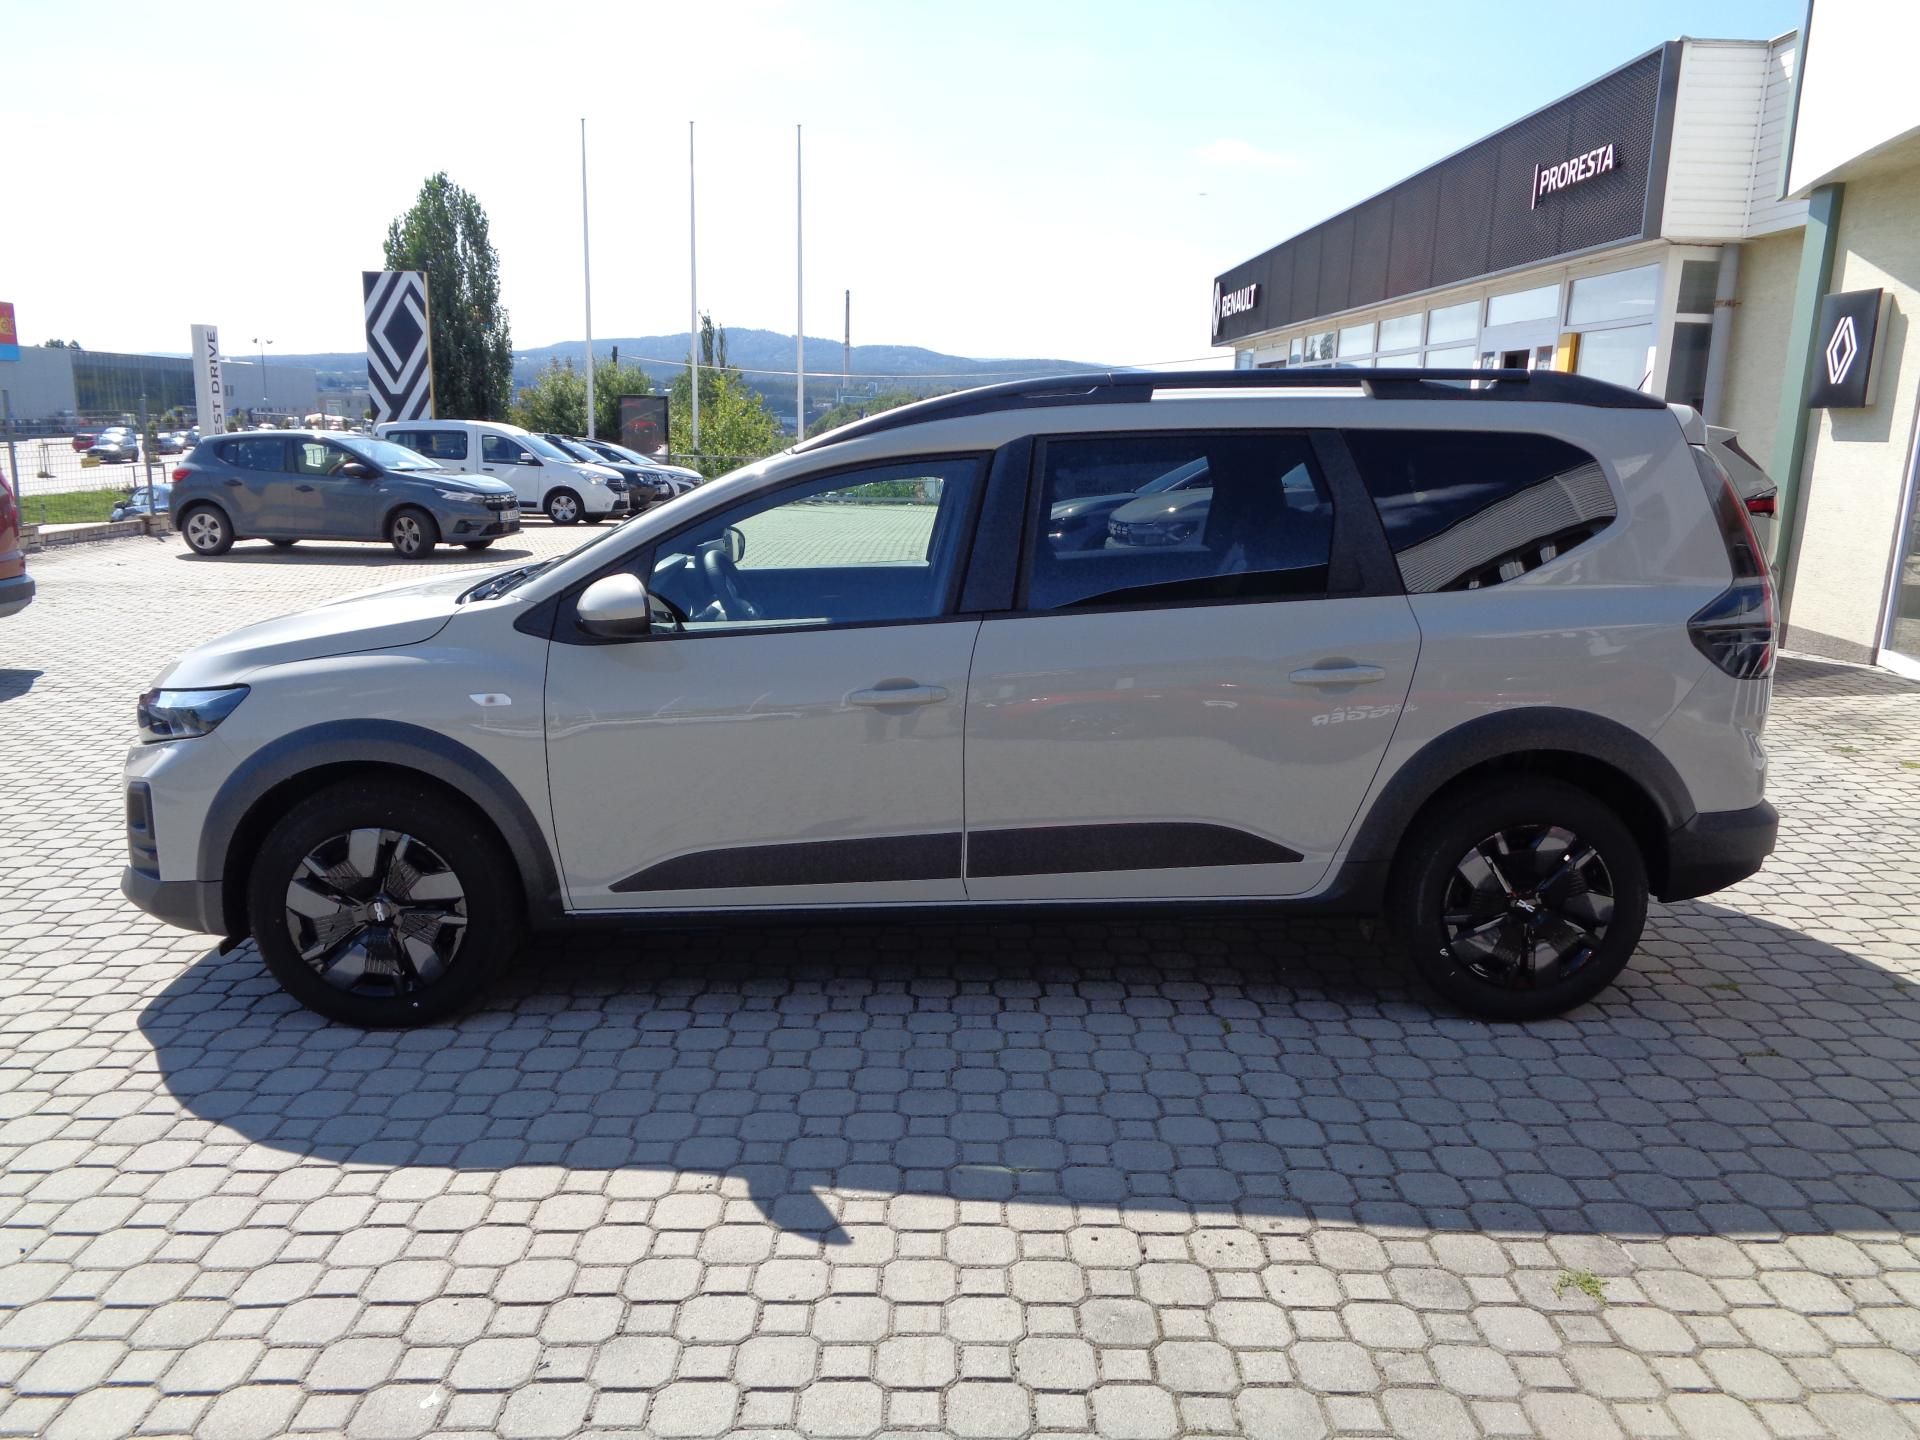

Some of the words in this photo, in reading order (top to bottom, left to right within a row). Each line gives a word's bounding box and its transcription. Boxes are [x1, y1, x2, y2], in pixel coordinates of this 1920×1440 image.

[1539, 143, 1614, 196] PRORESTA
[1221, 283, 1257, 318] RENAULT
[206, 331, 221, 394] DRIVE
[212, 402, 223, 435] EST
